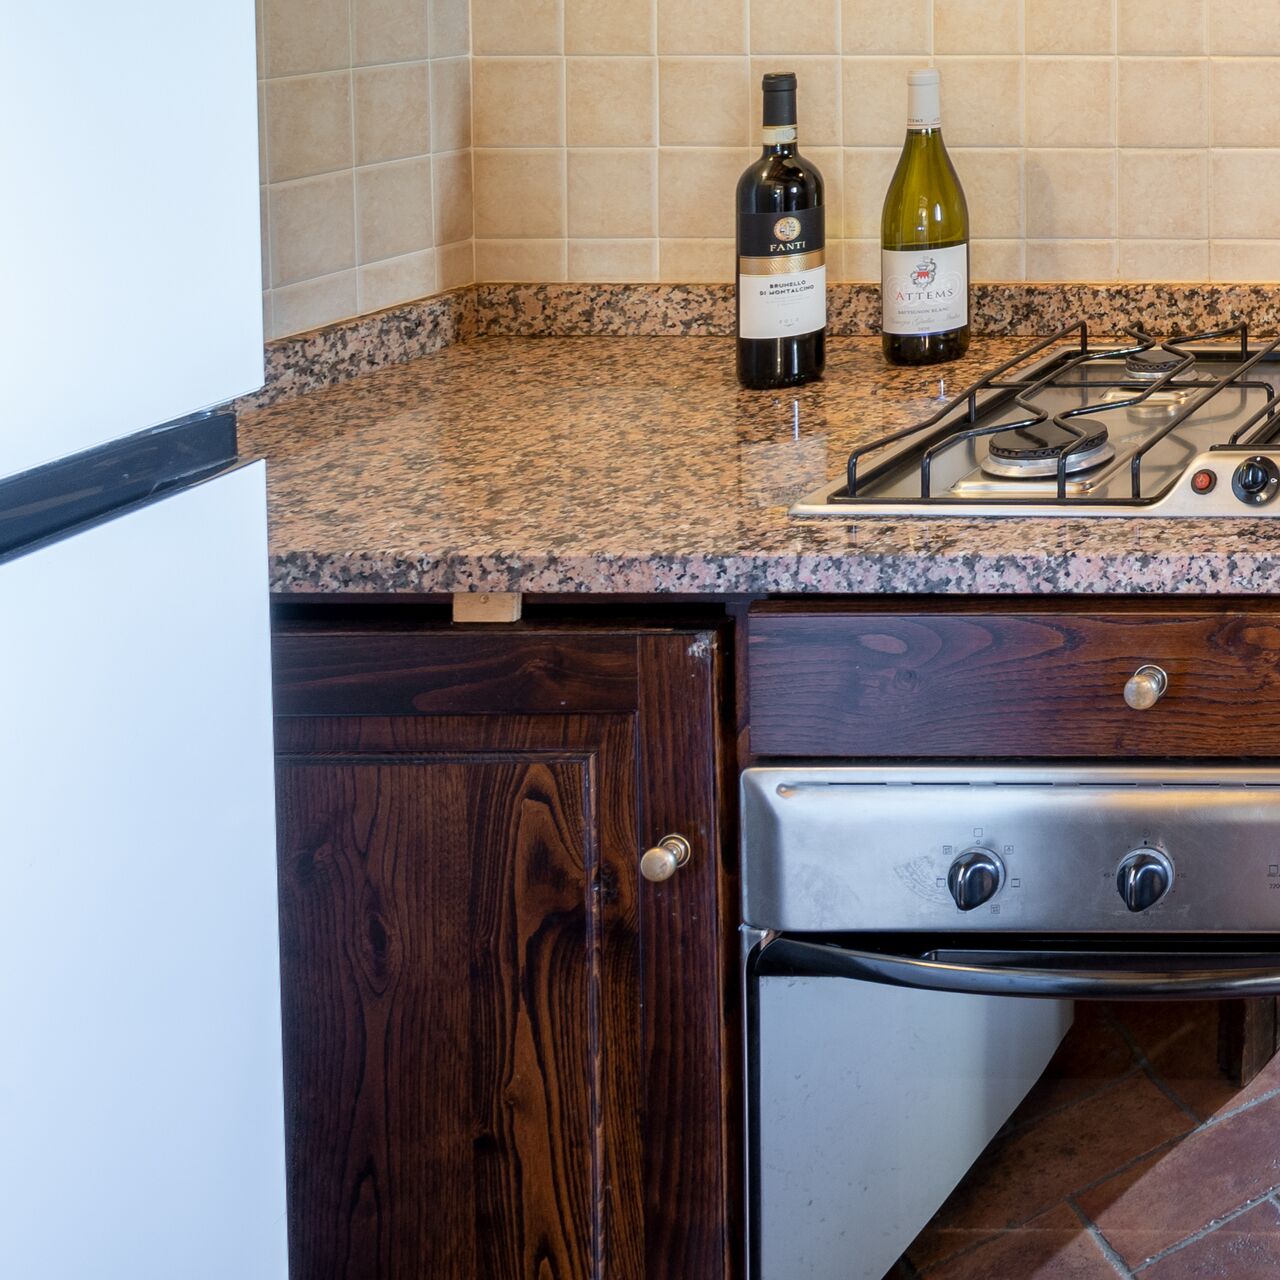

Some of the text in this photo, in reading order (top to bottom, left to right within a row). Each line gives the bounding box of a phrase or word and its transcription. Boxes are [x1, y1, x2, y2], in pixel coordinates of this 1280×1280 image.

[769, 240, 806, 252] FANTI
[769, 280, 806, 289] BRUNELLO
[769, 284, 815, 296] MONTALCINO
[896, 288, 953, 301] ATTEMS
